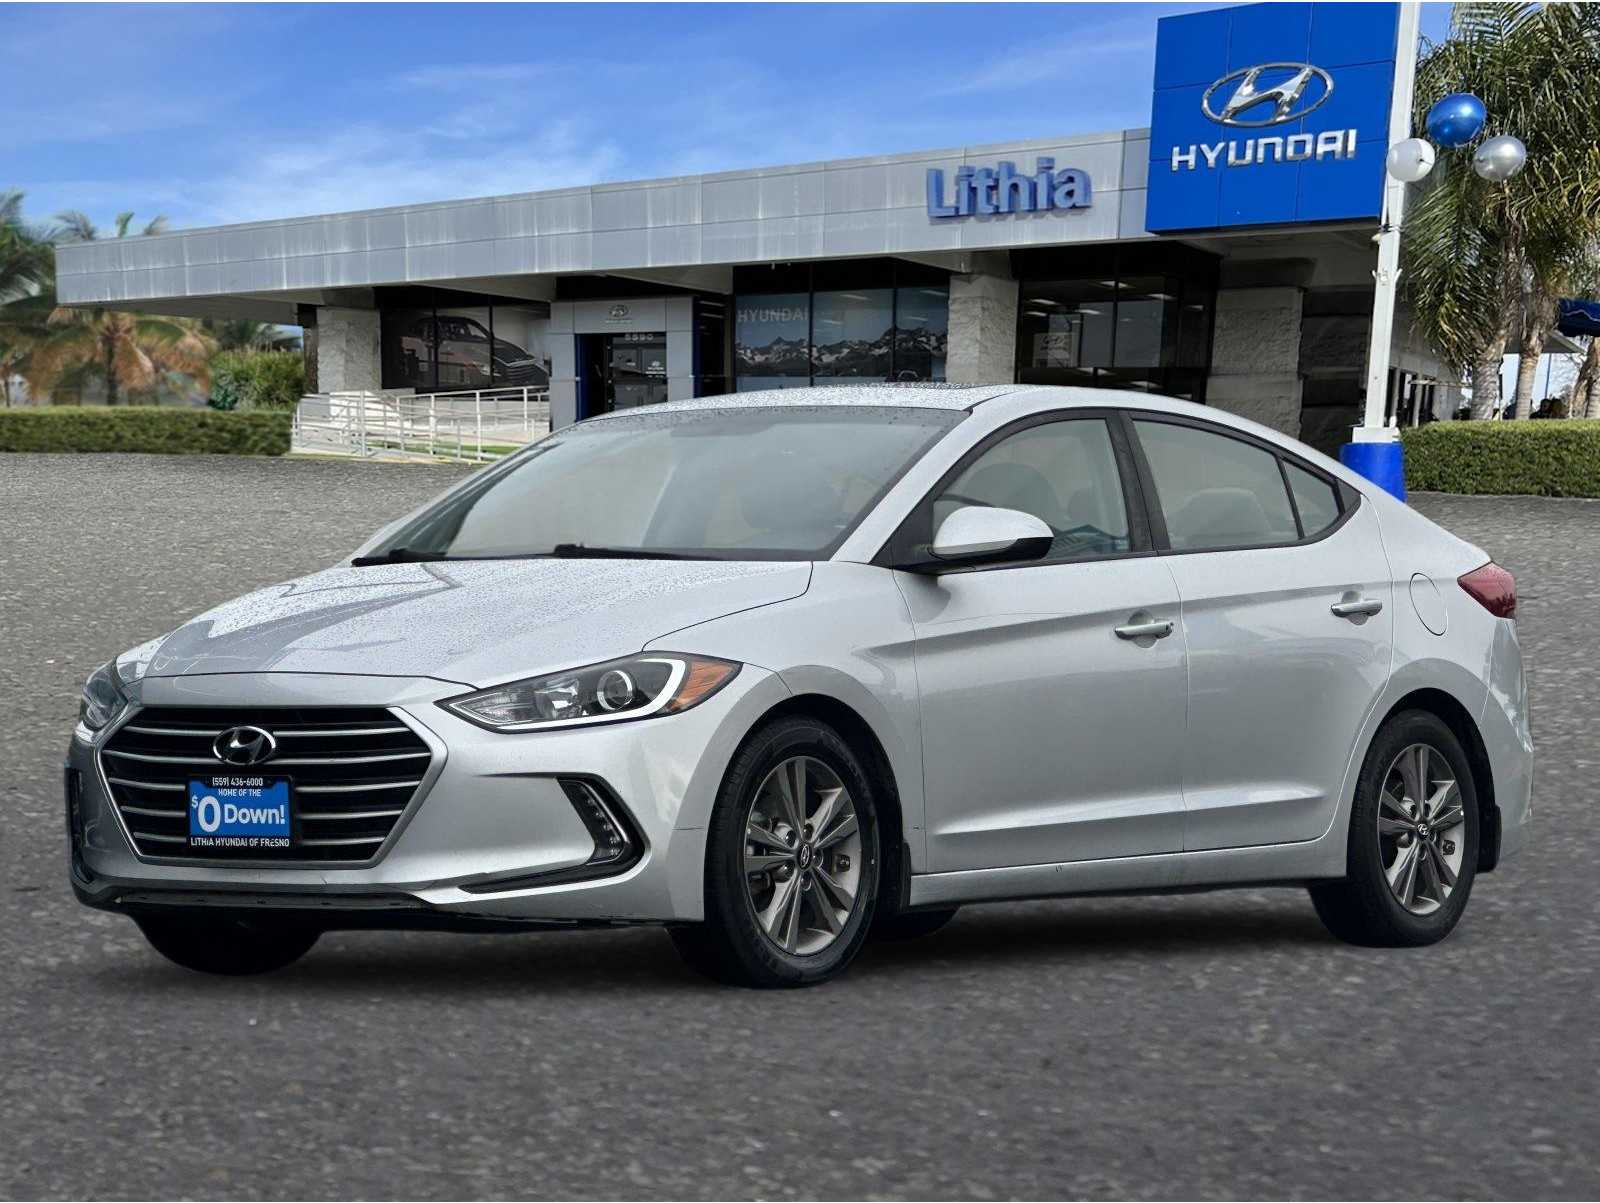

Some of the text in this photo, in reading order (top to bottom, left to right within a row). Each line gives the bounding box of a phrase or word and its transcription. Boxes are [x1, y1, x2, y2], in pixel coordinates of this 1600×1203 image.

[1171, 129, 1357, 171] HYUNDAI
[927, 157, 1092, 217] Lithia
[737, 307, 809, 322] HYUNDAI
[212, 777, 263, 786] (559) 436-6000
[219, 789, 262, 797] HOME OF THE
[224, 804, 285, 825] Down!
[191, 838, 290, 847] LITHIA HYUNDAI OF FRESNO
